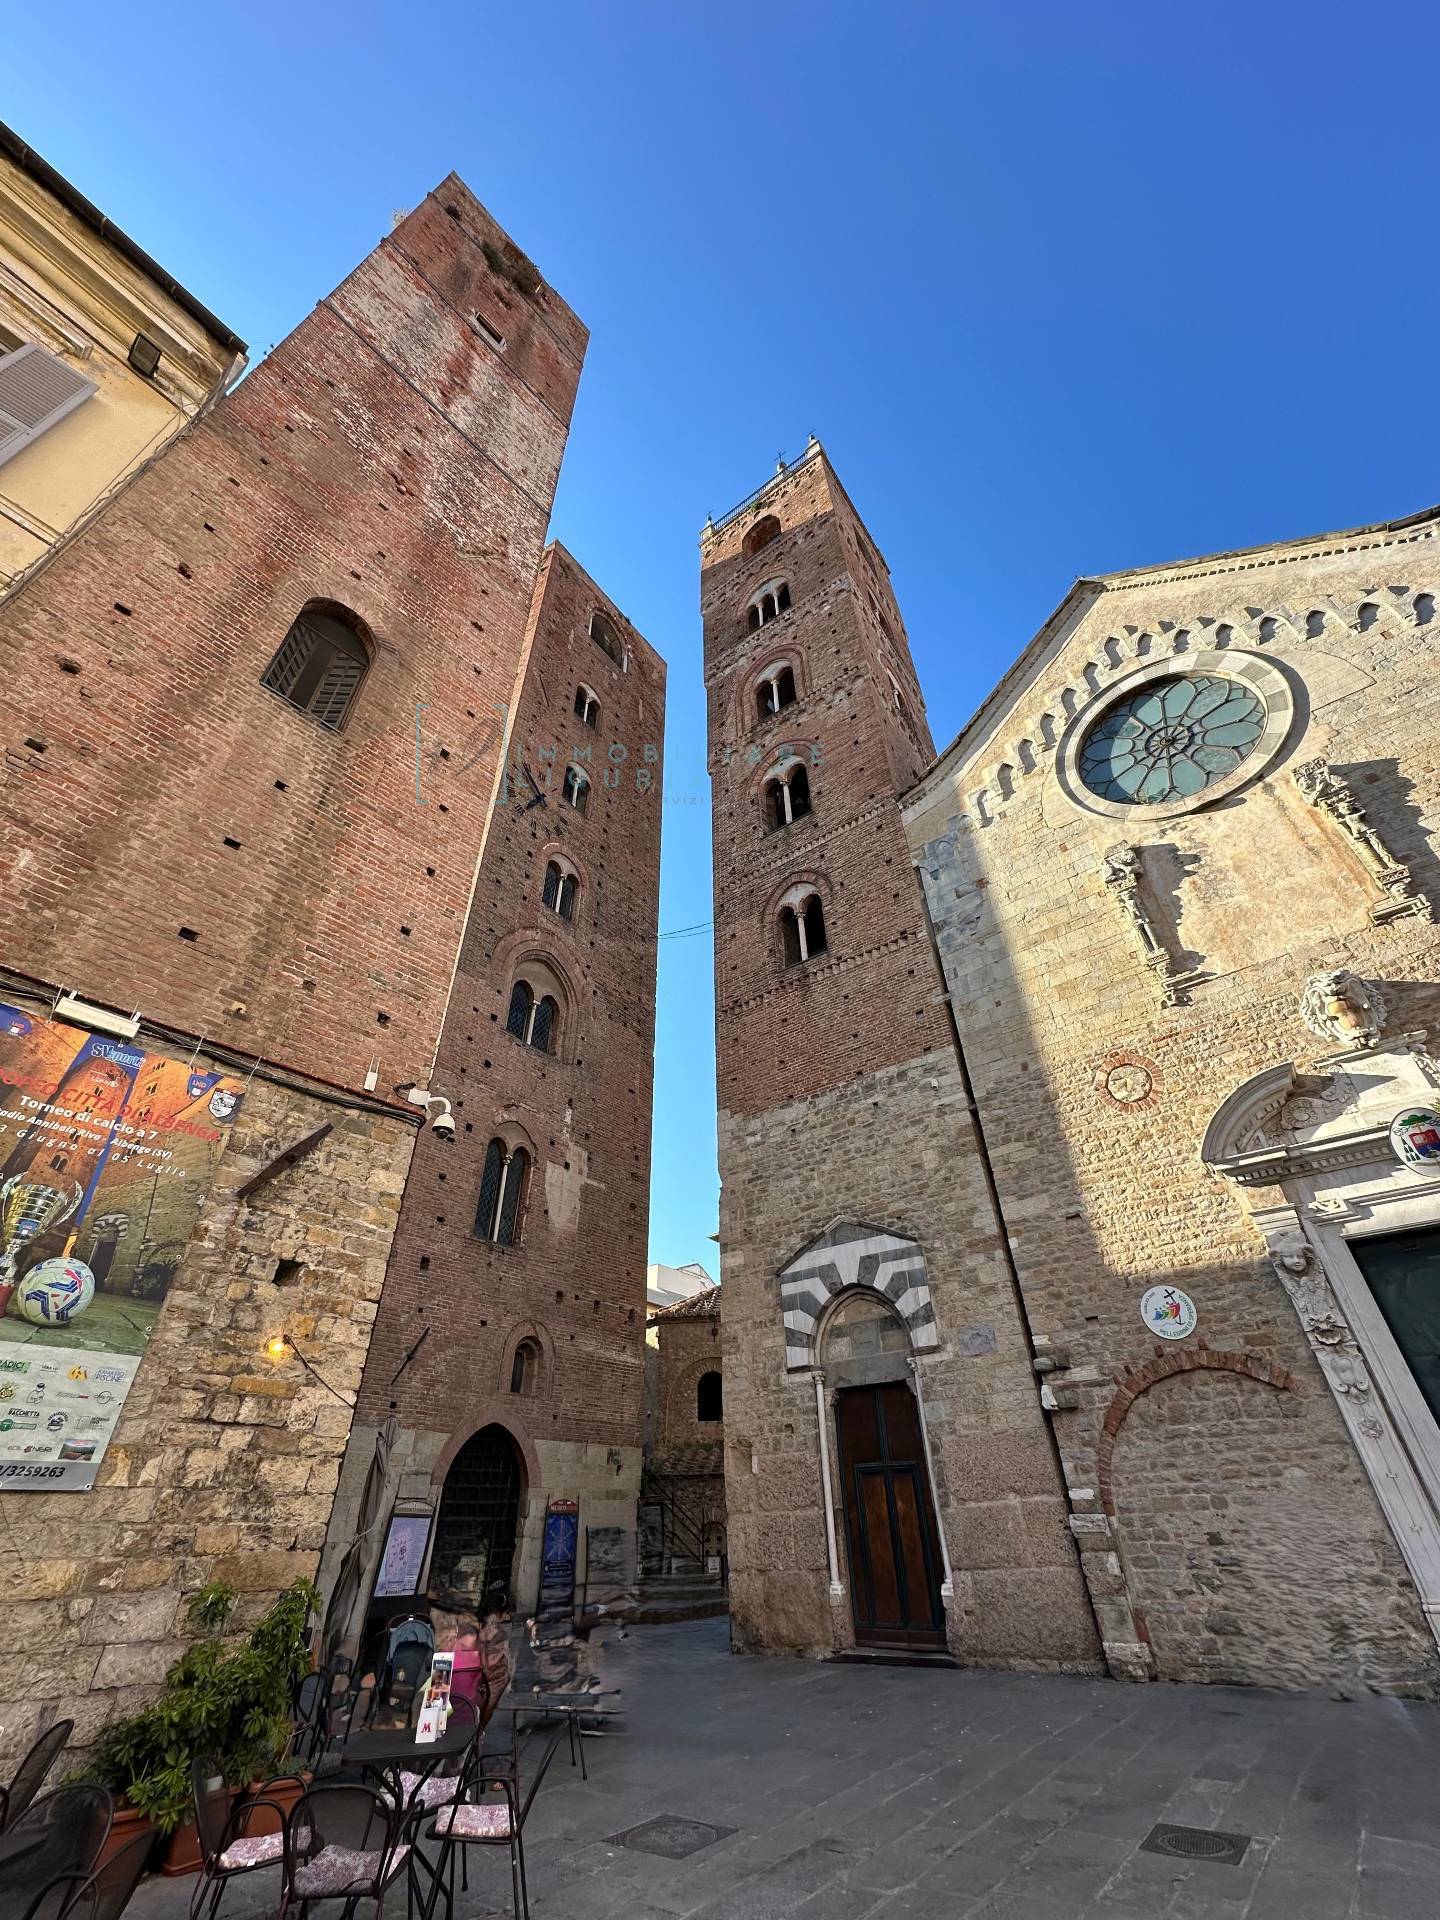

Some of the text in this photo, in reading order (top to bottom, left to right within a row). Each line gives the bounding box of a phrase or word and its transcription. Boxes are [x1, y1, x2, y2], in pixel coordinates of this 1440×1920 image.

[20, 1095, 159, 1140] Torneo di calcio a 7
[26, 1116, 77, 1135] Annibale
[77, 1128, 102, 1141] Riva
[110, 1137, 152, 1156] Albenga
[152, 1147, 173, 1160] (SV)
[16, 1129, 79, 1151] Giugno
[87, 1147, 105, 1157] al
[111, 1152, 131, 1164] 05
[137, 1159, 187, 1178] Luglio
